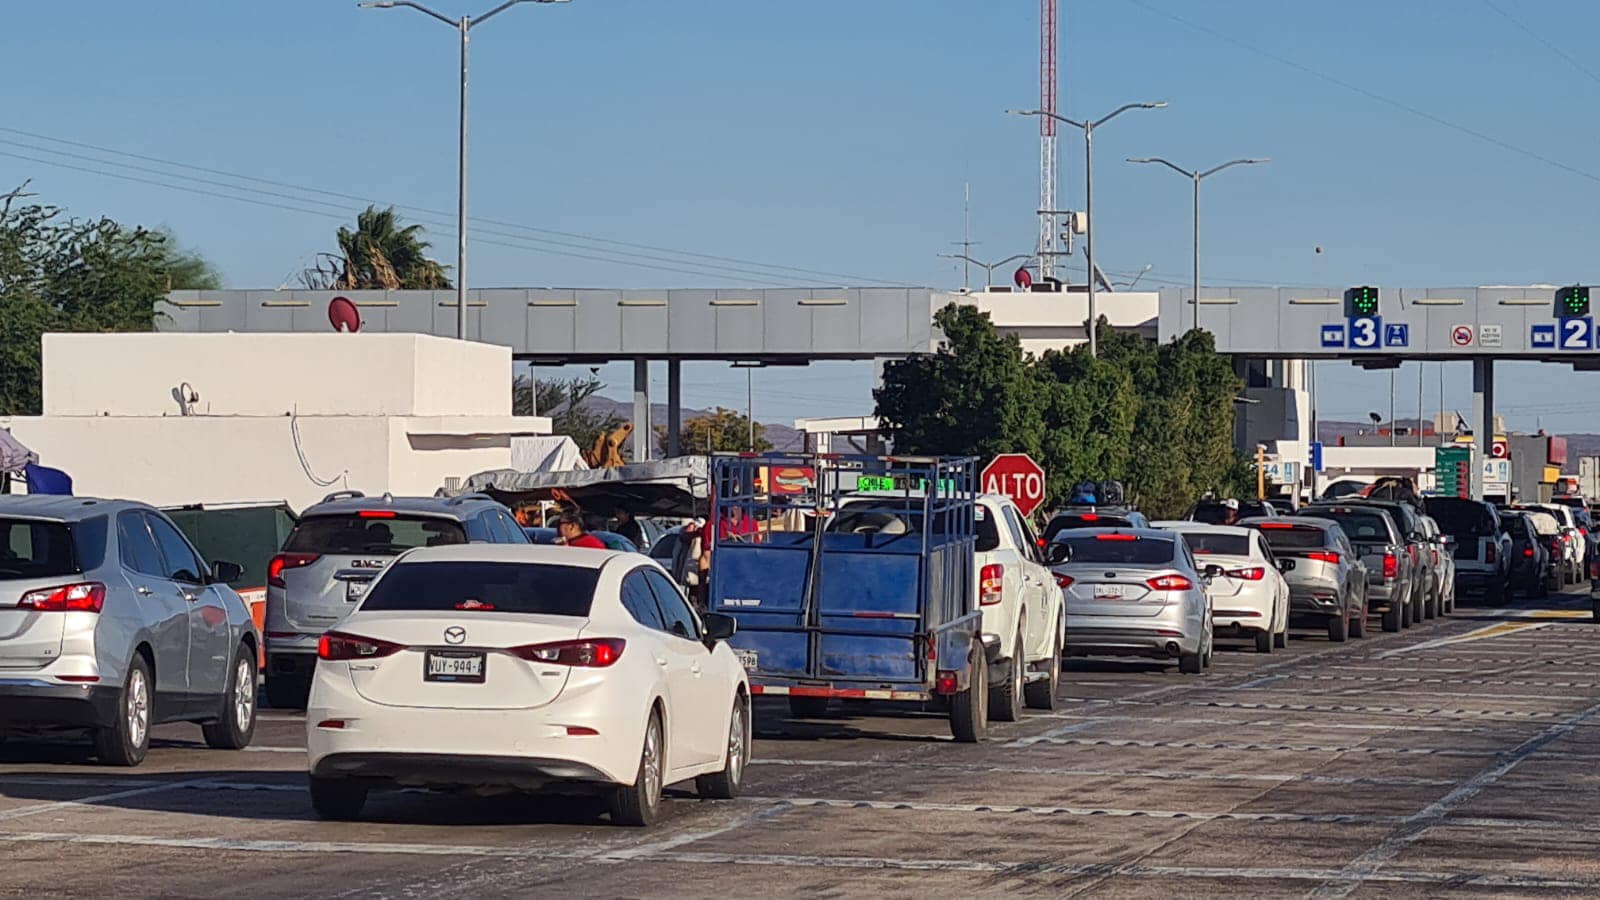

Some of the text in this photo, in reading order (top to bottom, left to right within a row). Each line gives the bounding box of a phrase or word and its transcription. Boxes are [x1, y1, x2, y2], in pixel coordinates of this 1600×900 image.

[1354, 318, 1376, 346] 3
[1564, 319, 1588, 347] 2
[986, 473, 1041, 499] ALTO
